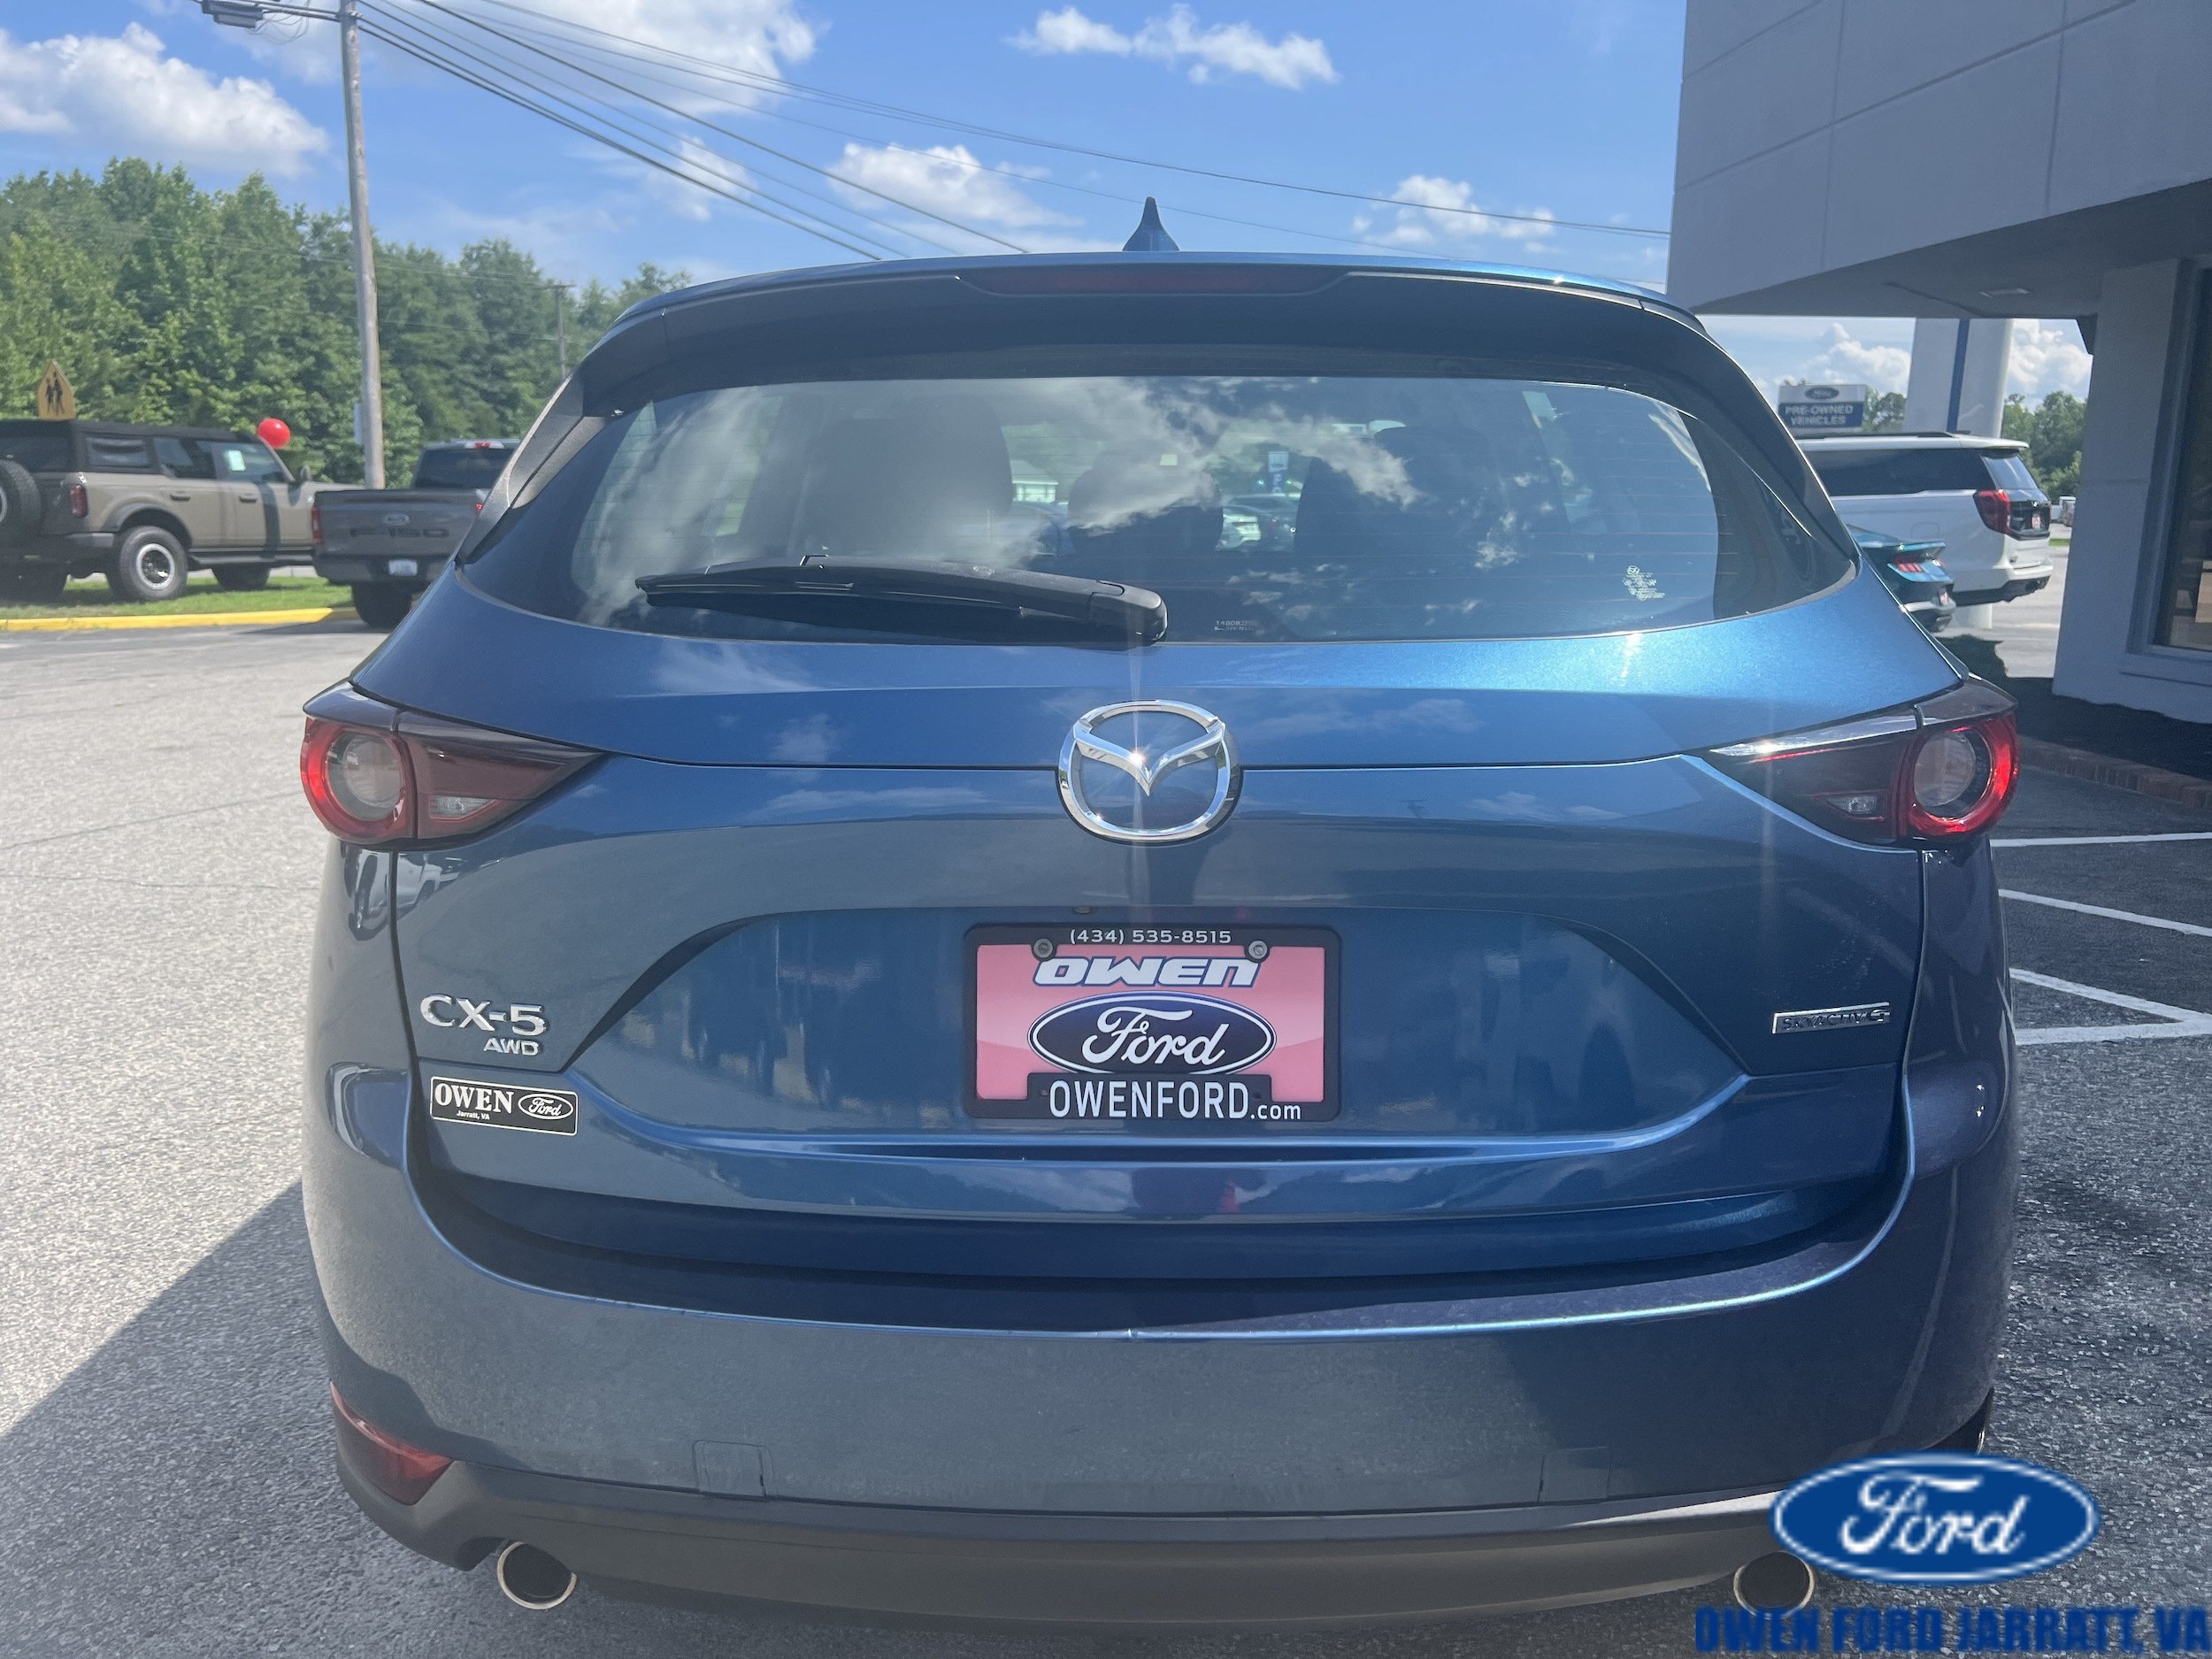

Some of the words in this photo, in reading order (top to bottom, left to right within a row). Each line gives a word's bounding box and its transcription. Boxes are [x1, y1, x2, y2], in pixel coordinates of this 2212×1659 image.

[1785, 403, 1854, 415] PRE-OWNED
[1791, 415, 1847, 426] VEHICLES
[1070, 930, 1125, 944] (434)
[1132, 930, 1233, 944] 535-8515
[420, 994, 547, 1036] CX-5
[1081, 1006, 1230, 1065] Ford
[483, 1038, 540, 1056] AWD
[434, 1083, 514, 1114] OWEN
[528, 1097, 562, 1117] Ford
[1049, 1080, 1302, 1120] OWENFORD.com
[456, 1110, 480, 1120] Jarratt,
